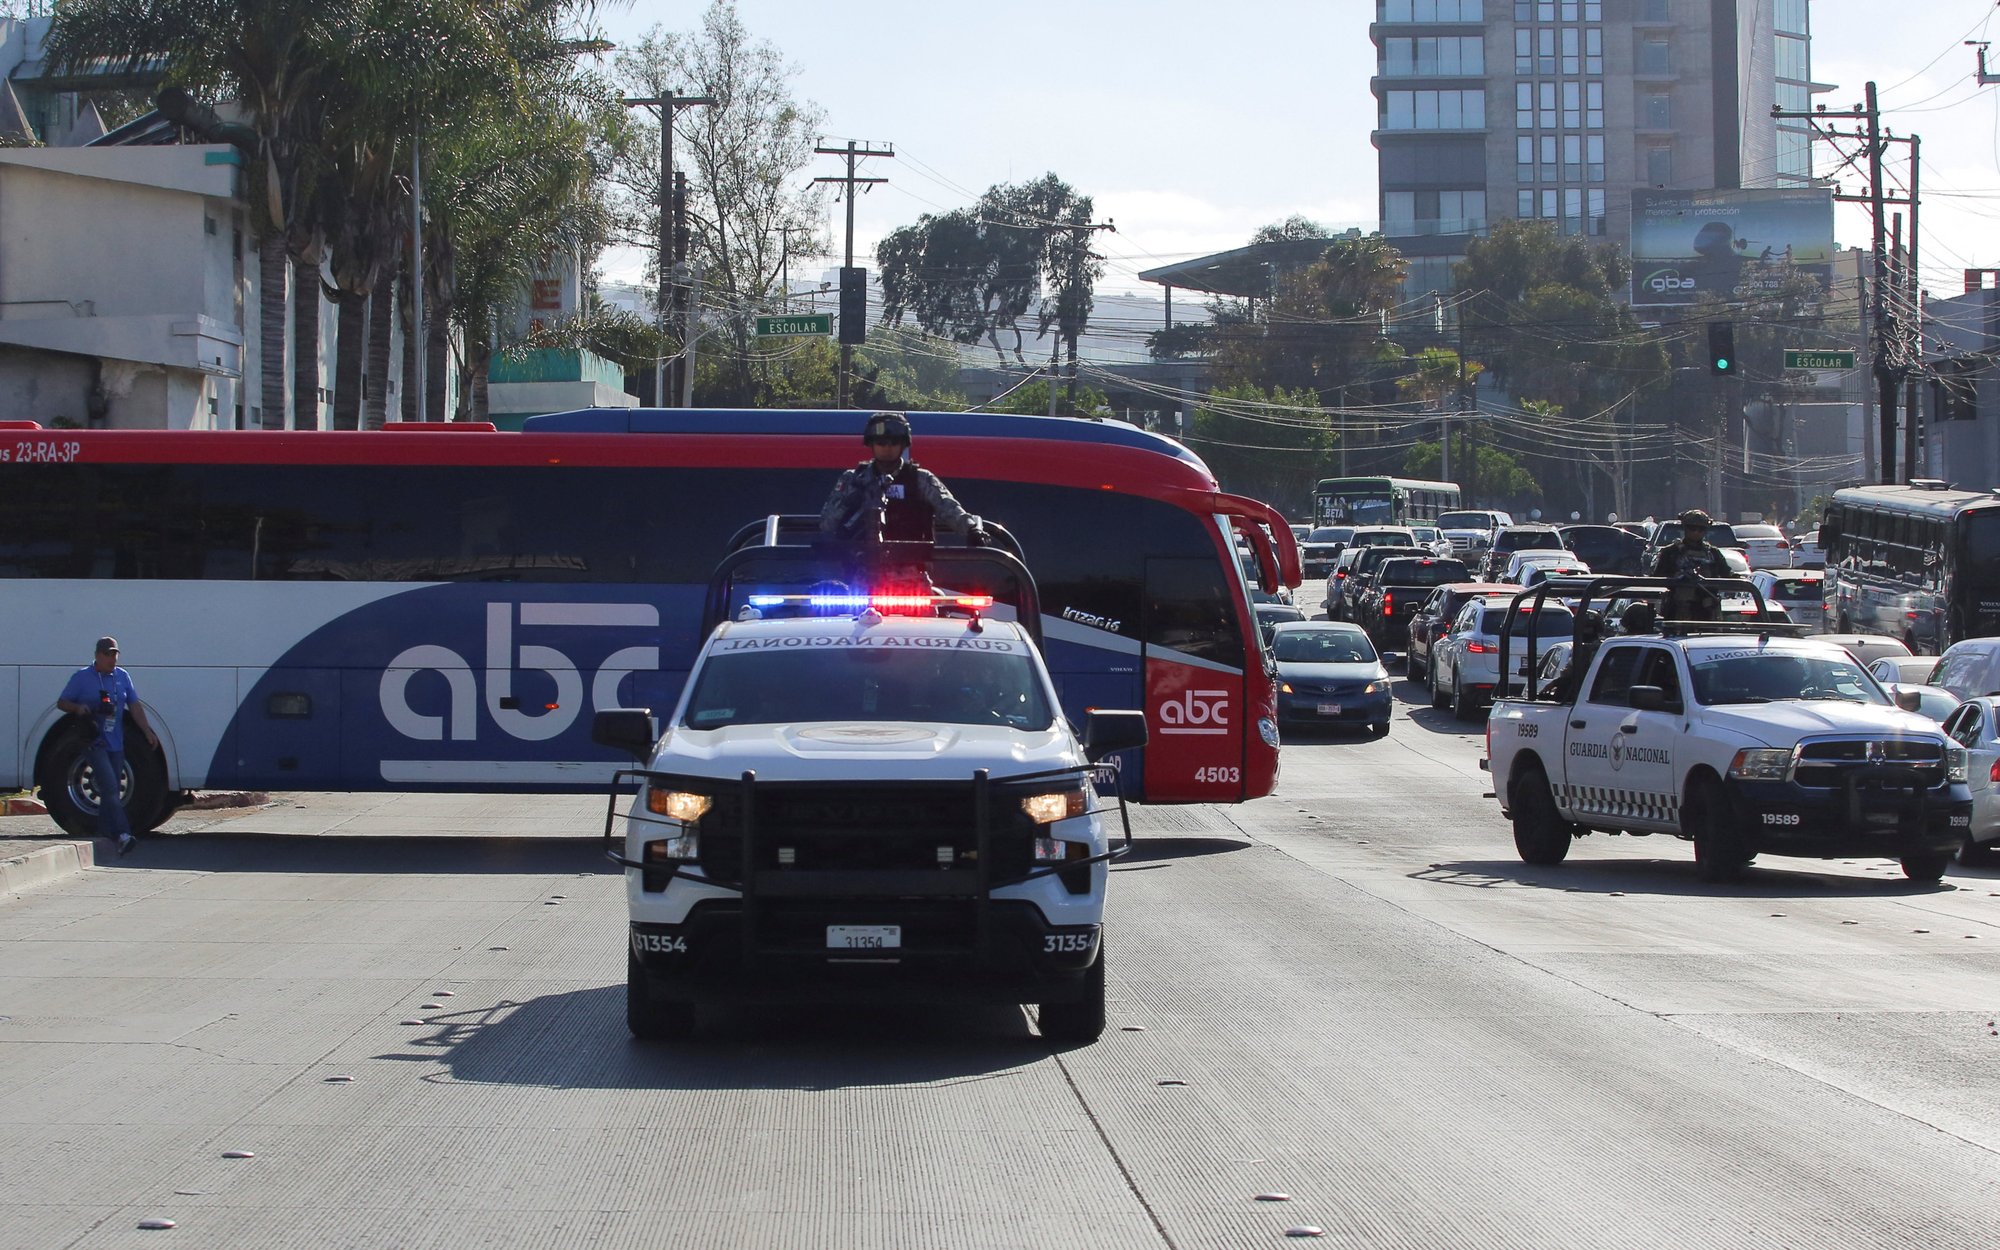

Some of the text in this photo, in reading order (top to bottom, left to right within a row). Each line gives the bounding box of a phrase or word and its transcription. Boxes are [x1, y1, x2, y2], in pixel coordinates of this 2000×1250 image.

[1694, 206, 1740, 217] protección
[1651, 276, 1695, 292] gba
[769, 323, 817, 333] ESCOLAR
[1796, 358, 1842, 367] ESCOLAR
[16, 442, 80, 462] 23-RA-3P
[1325, 508, 1344, 519] BETA
[379, 602, 660, 741] abc
[1160, 690, 1229, 725] abc
[1517, 723, 1539, 738] 19589
[1570, 742, 1670, 764] GUARDIA NACIONAL
[1194, 766, 1240, 783] 4503
[1761, 813, 1800, 825] 19589
[635, 932, 688, 952] 31354
[845, 936, 883, 949] 31354
[1043, 933, 1096, 952] 31354
